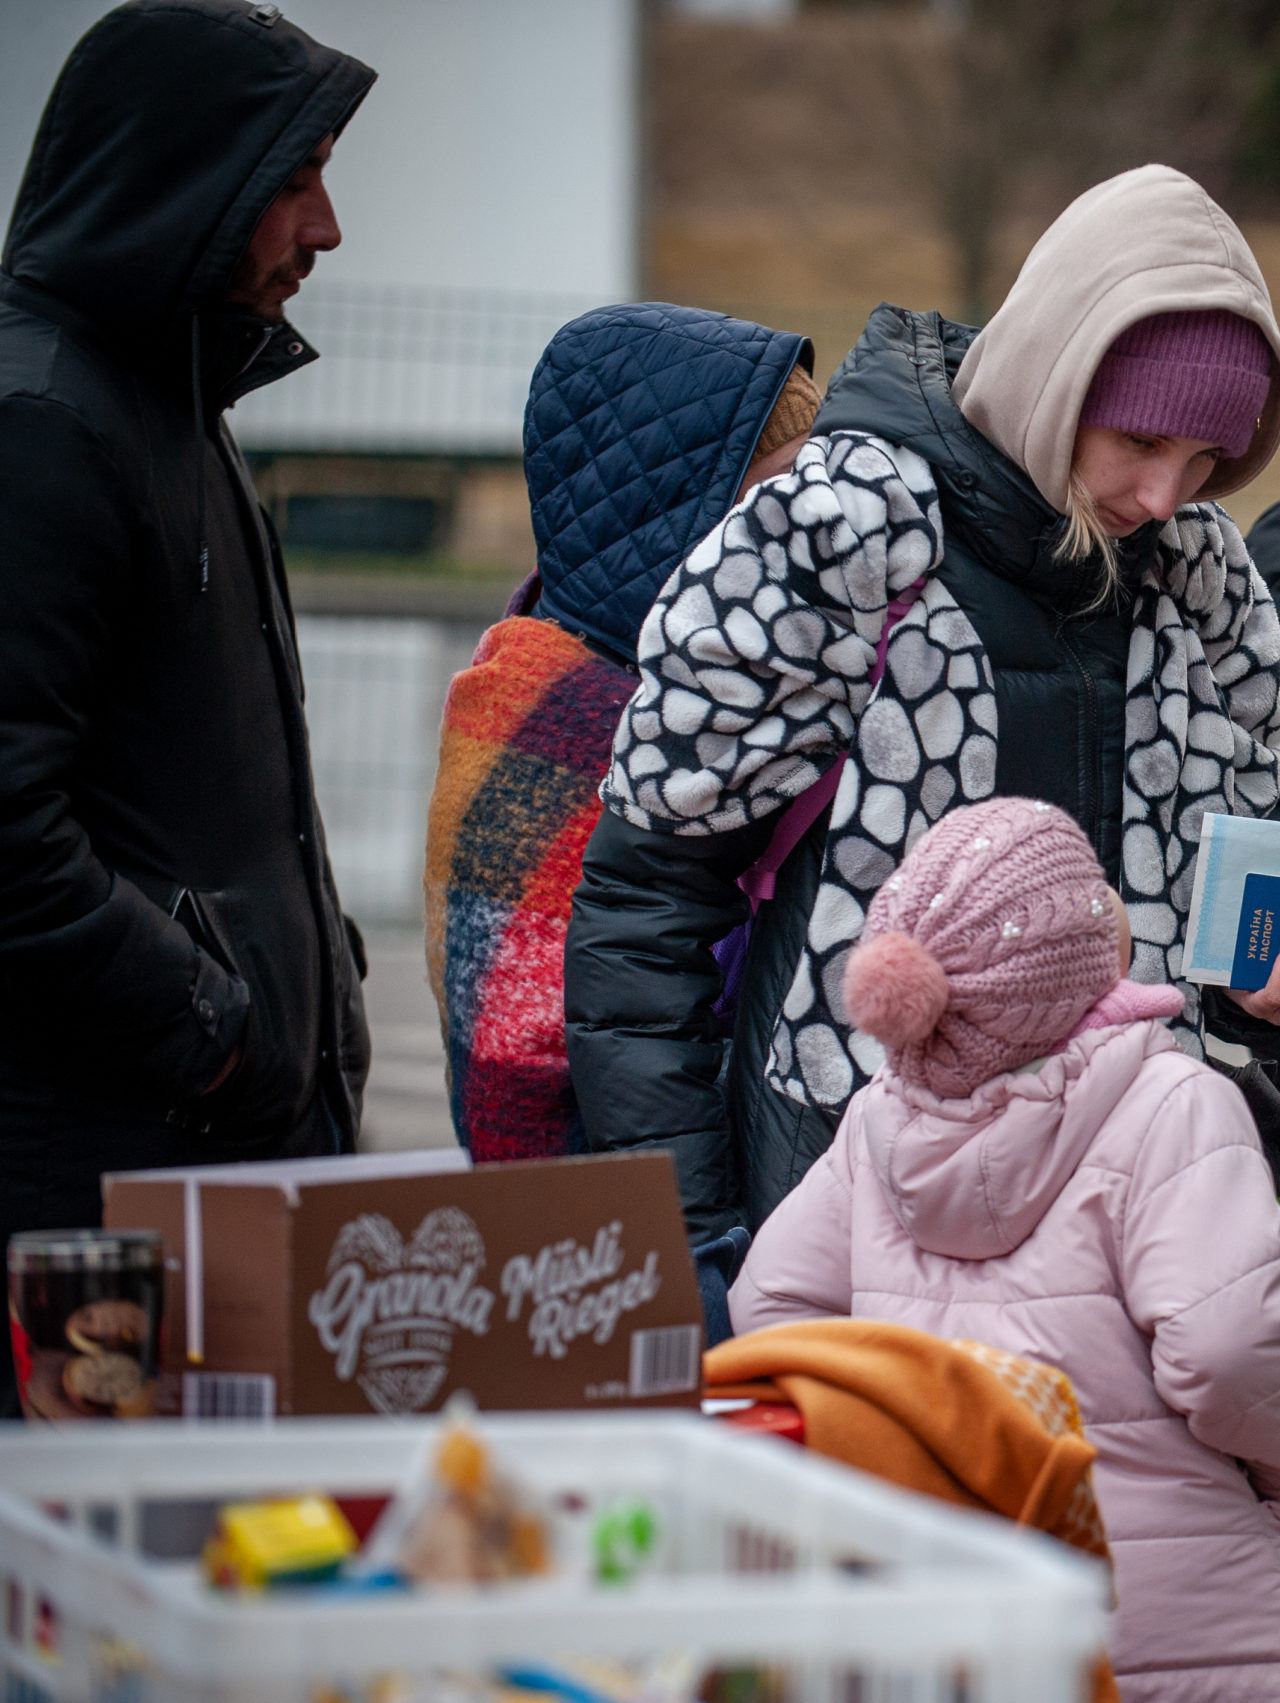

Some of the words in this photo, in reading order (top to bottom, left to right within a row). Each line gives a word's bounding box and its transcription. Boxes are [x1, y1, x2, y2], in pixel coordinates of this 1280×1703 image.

[1247, 909, 1263, 959] УКРАЇНА
[1259, 910, 1275, 961] ПАСПОРТ
[309, 1261, 497, 1381] Granola
[502, 1219, 625, 1321] Müsli
[528, 1251, 662, 1358] Riegel
